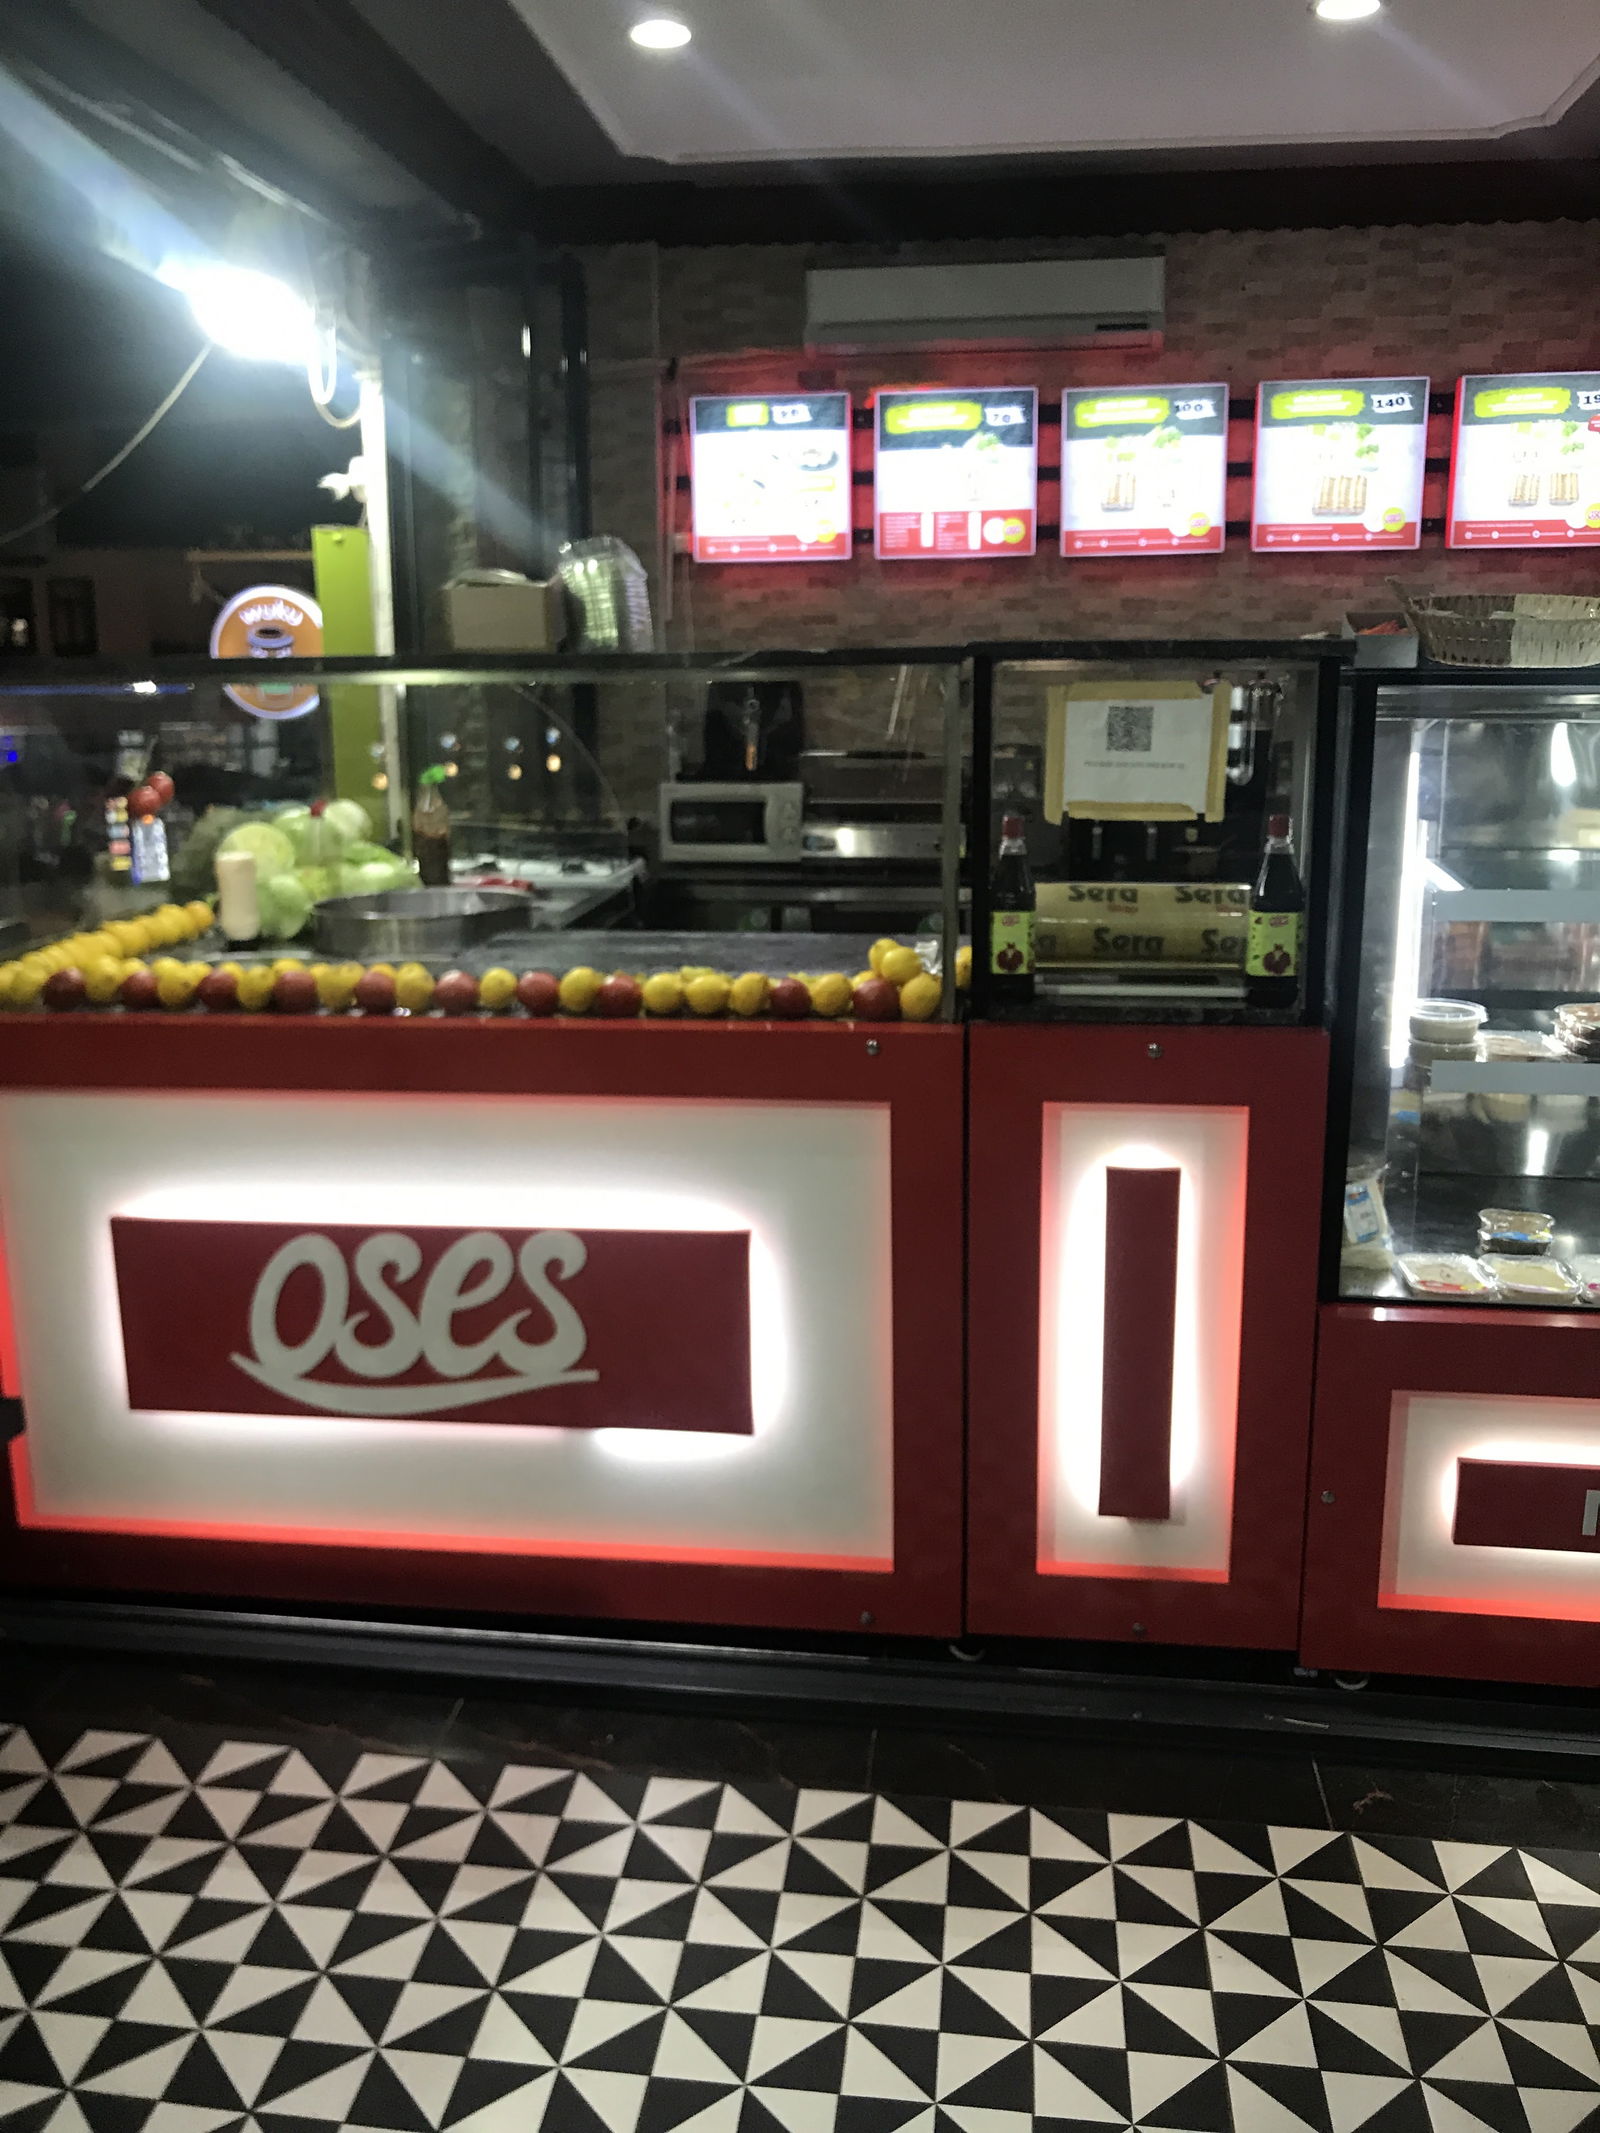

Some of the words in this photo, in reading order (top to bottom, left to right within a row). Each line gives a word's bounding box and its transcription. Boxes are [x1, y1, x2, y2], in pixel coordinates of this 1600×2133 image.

[1375, 396, 1405, 409] 140
[1068, 885, 1138, 903] Sera
[1093, 927, 1164, 957] Sera
